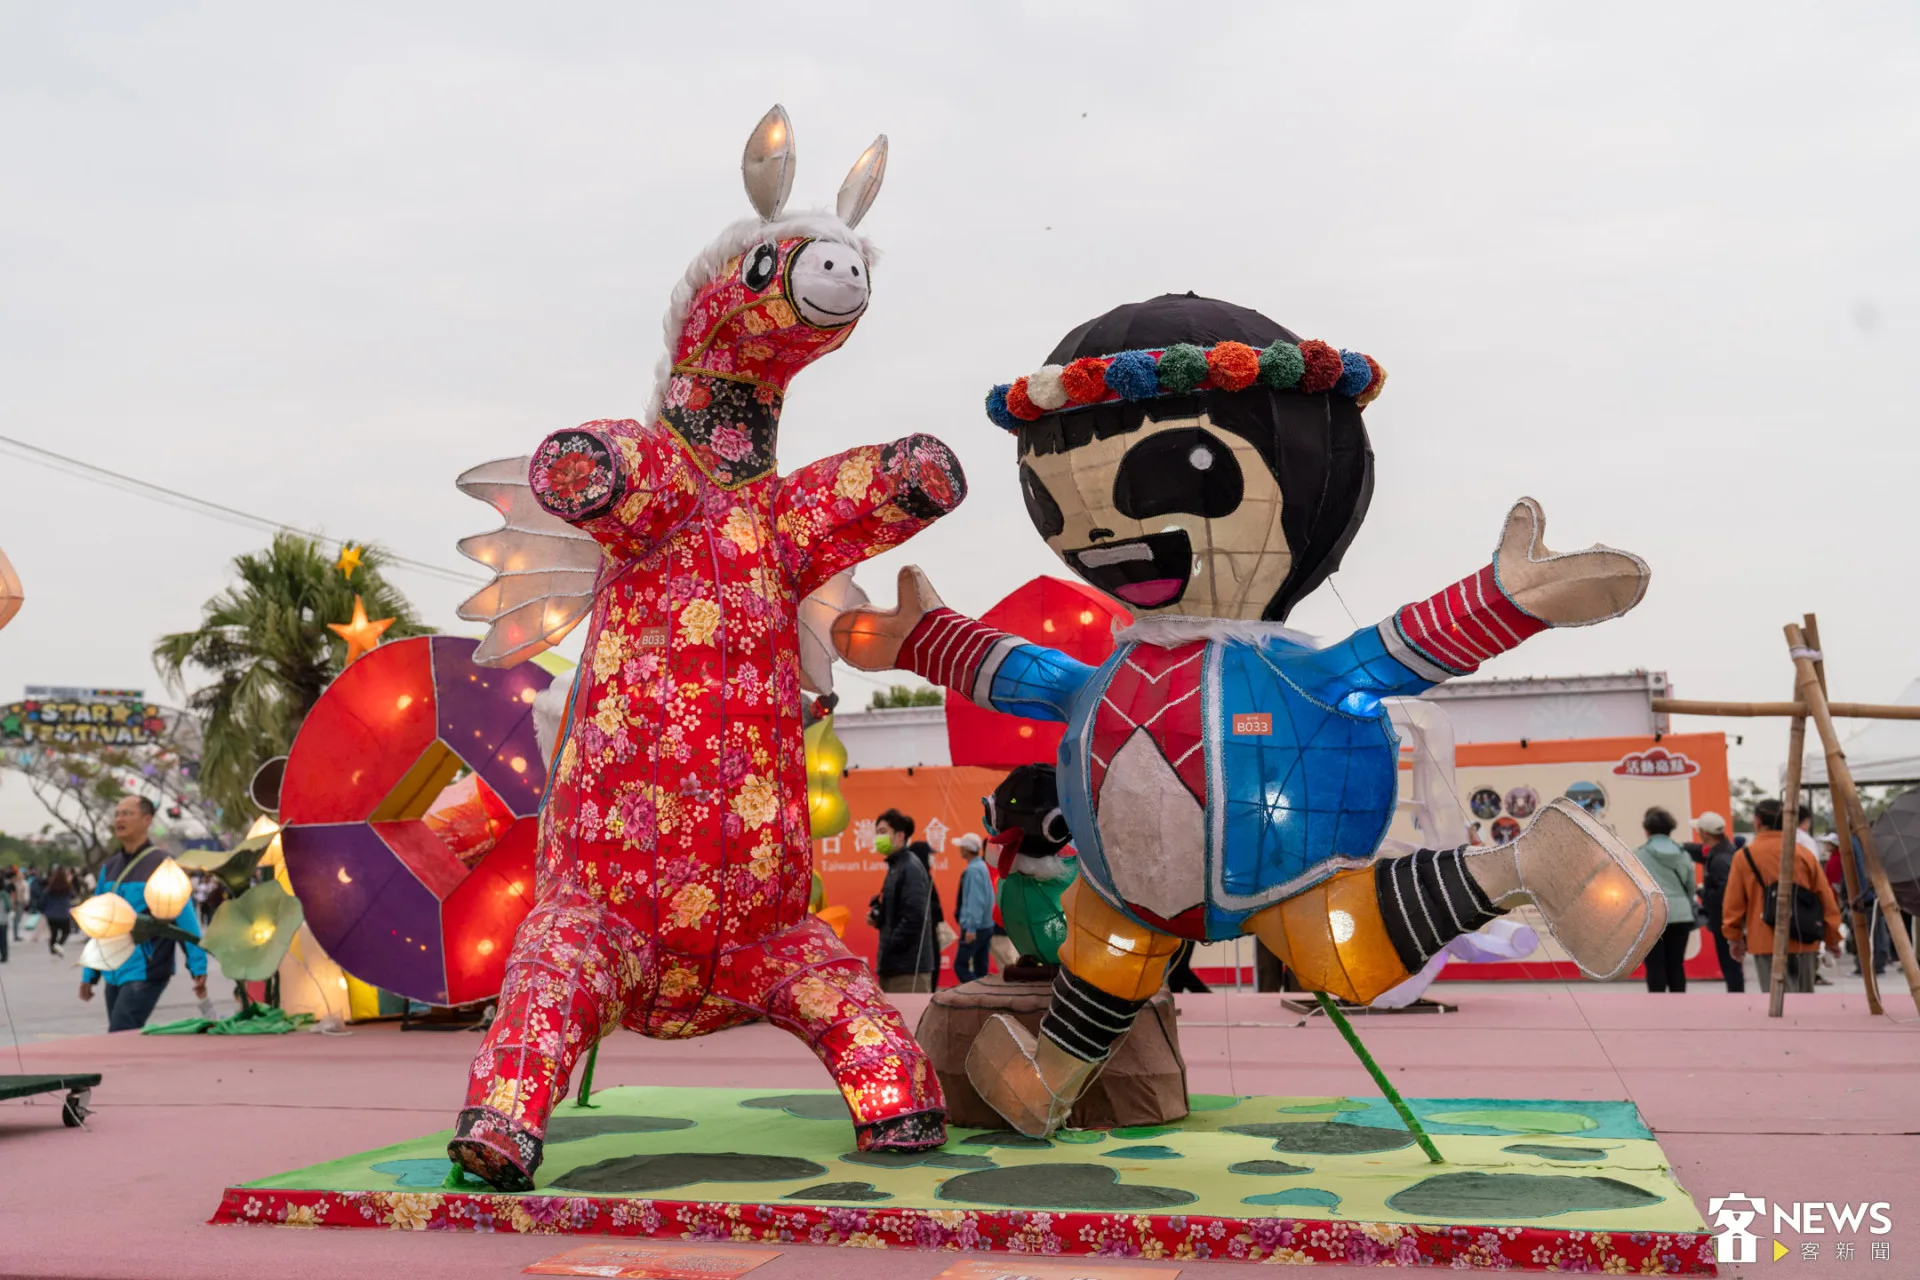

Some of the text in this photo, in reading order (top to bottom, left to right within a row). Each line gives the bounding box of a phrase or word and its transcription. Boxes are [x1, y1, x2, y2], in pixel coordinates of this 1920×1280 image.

[641, 634, 666, 645] B033
[40, 703, 109, 722] STAR
[1237, 721, 1268, 732] B033
[822, 817, 950, 855] 台灣會
[821, 860, 860, 872] Taiwan
